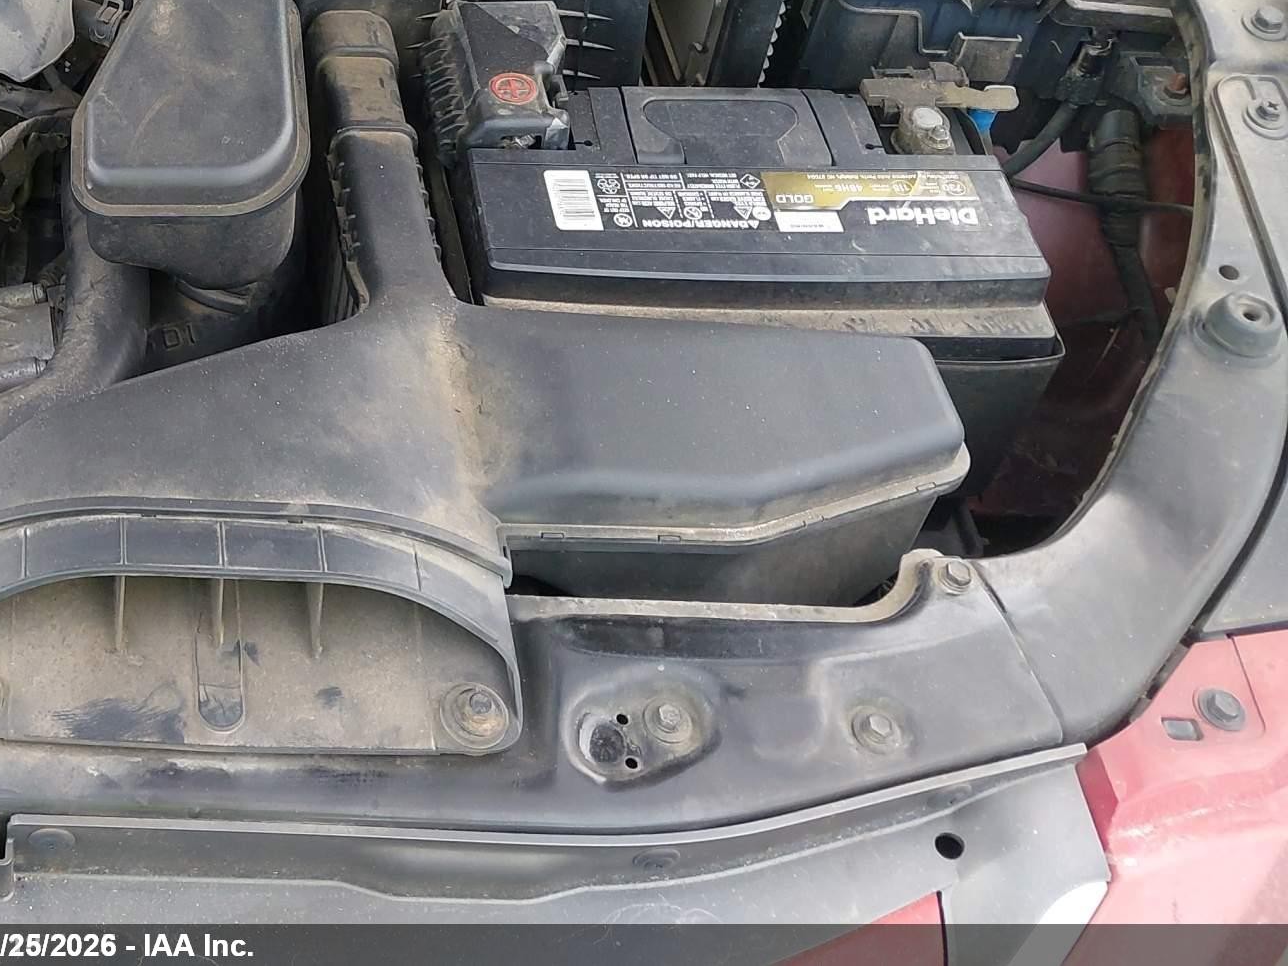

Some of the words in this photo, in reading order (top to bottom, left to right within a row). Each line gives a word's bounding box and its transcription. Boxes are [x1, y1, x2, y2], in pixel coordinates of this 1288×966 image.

[775, 194, 814, 203] GOLD
[866, 206, 979, 225] DieHard
[642, 219, 749, 229] DANGER/POISON
